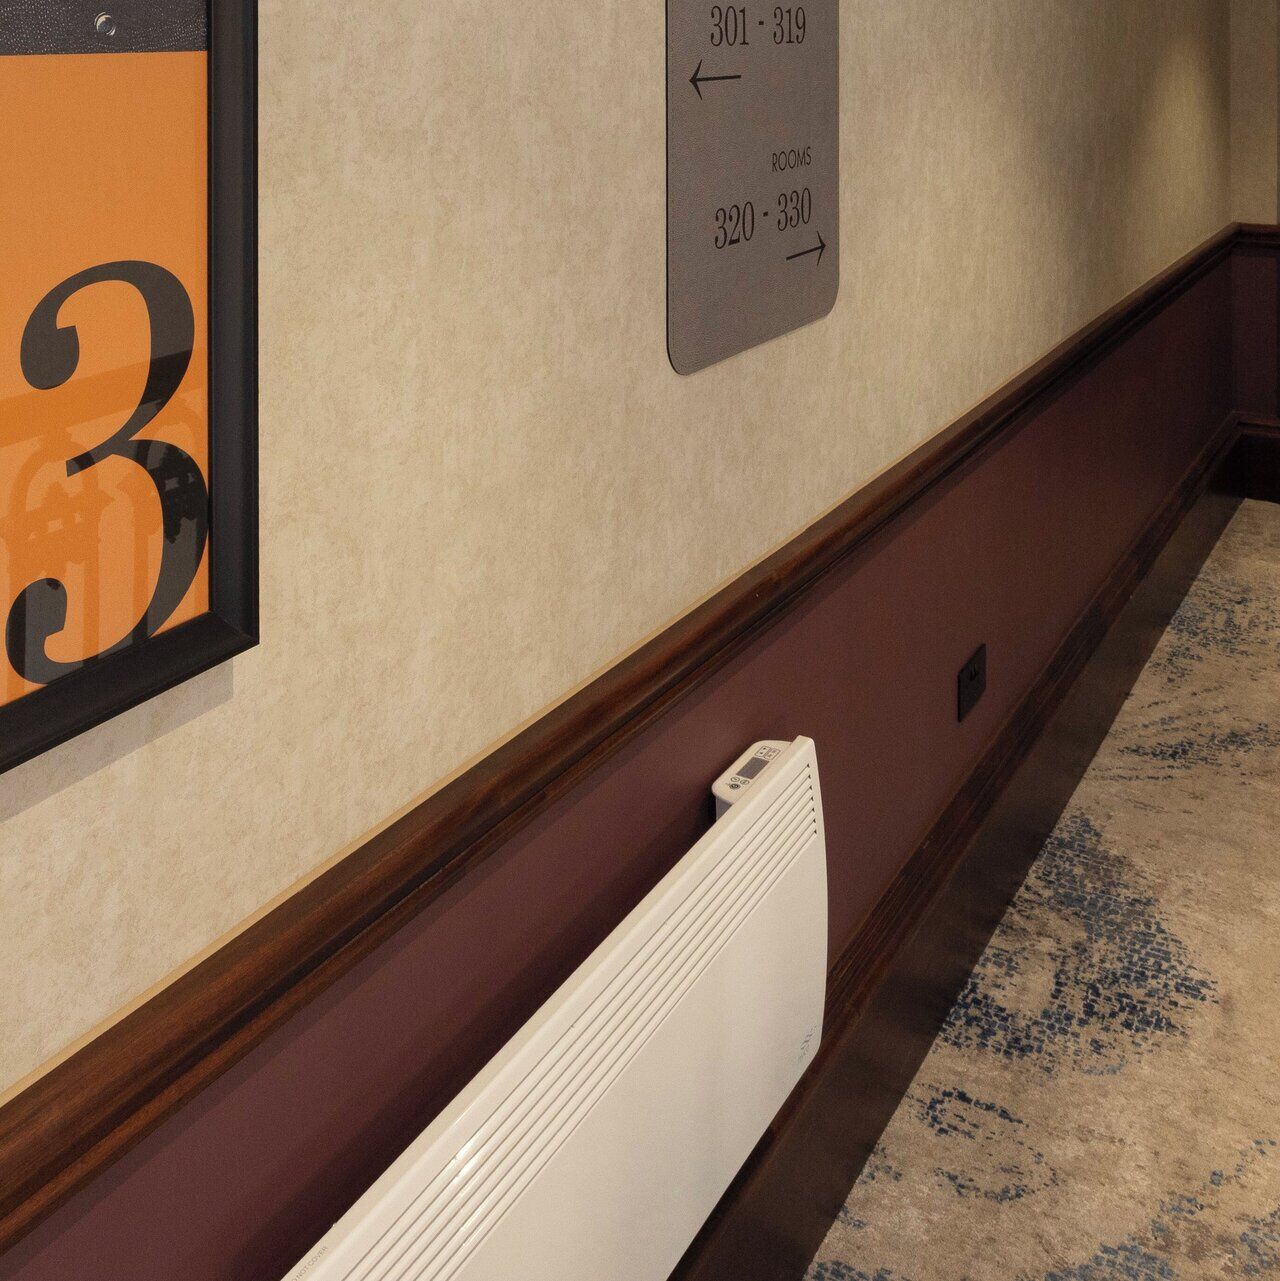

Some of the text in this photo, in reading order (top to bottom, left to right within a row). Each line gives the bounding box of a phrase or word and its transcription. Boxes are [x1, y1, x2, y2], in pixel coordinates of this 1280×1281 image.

[710, 6, 749, 47] 301
[773, 6, 806, 45] 319
[771, 146, 812, 172] ROOMS
[714, 201, 755, 249] 320
[777, 187, 812, 232] 330
[5, 260, 209, 685] 3
